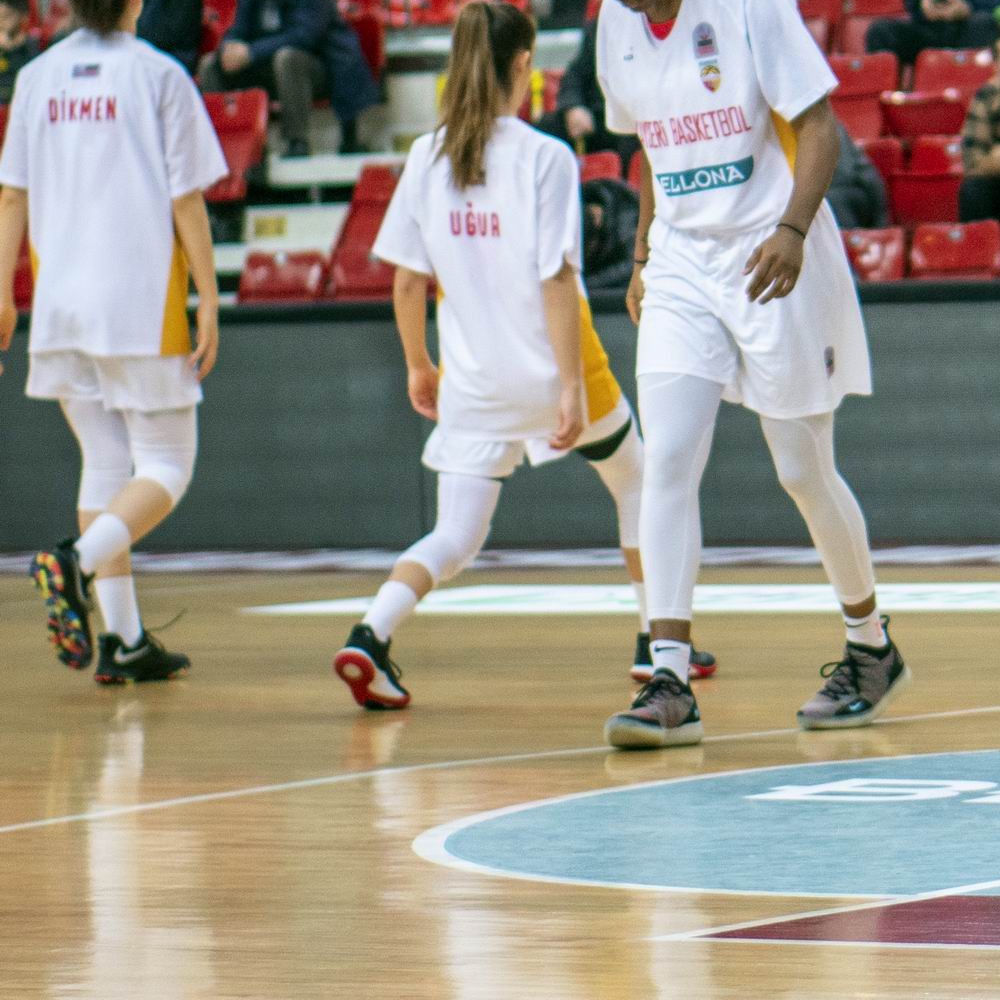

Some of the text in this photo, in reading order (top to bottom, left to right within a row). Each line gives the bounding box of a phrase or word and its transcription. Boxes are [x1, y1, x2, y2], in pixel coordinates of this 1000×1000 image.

[48, 89, 117, 123] DİKMEN
[669, 106, 751, 145] BASKETBOL
[659, 165, 744, 193] ELLONA
